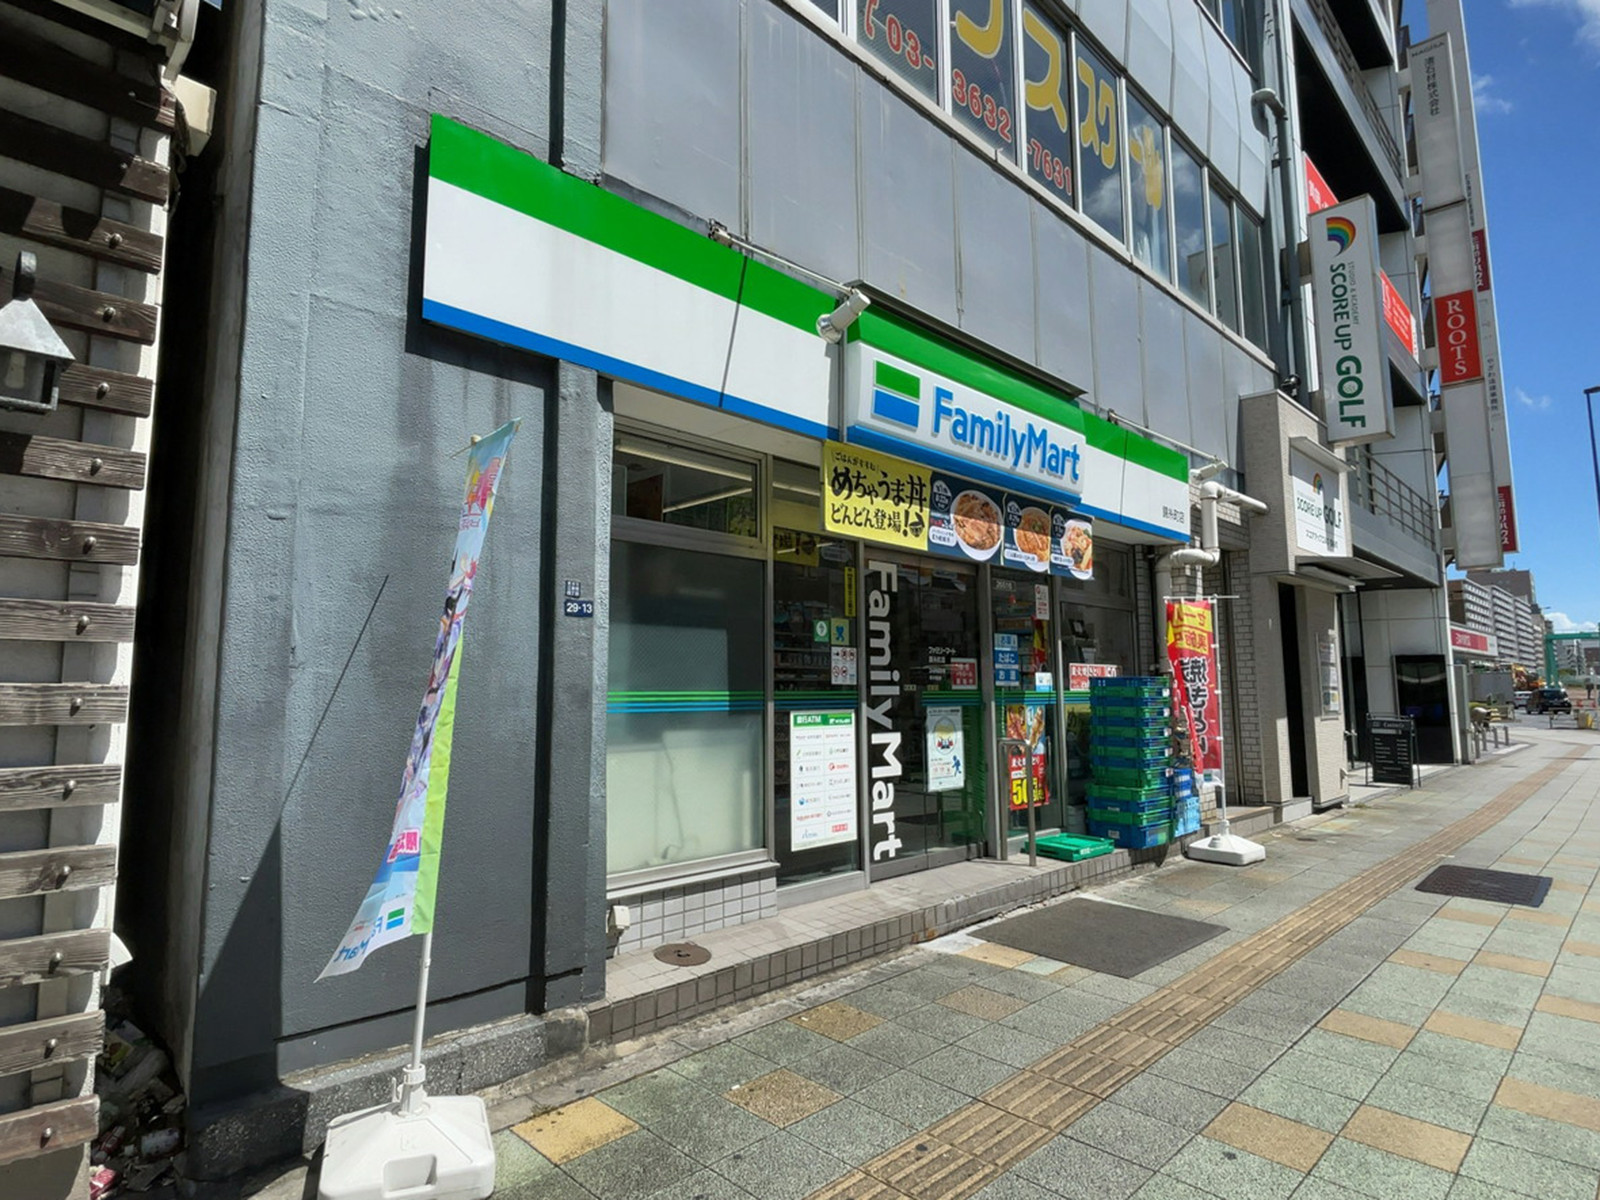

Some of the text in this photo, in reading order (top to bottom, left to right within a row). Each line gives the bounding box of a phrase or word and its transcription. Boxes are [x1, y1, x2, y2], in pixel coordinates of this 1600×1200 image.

[1330, 262, 1366, 428] SCORE UP GOLF
[1446, 299, 1468, 376] ROOTS
[933, 386, 1081, 482] FamilyMart
[831, 465, 927, 513] めちゃうま丼
[867, 560, 902, 861] FamilyMart
